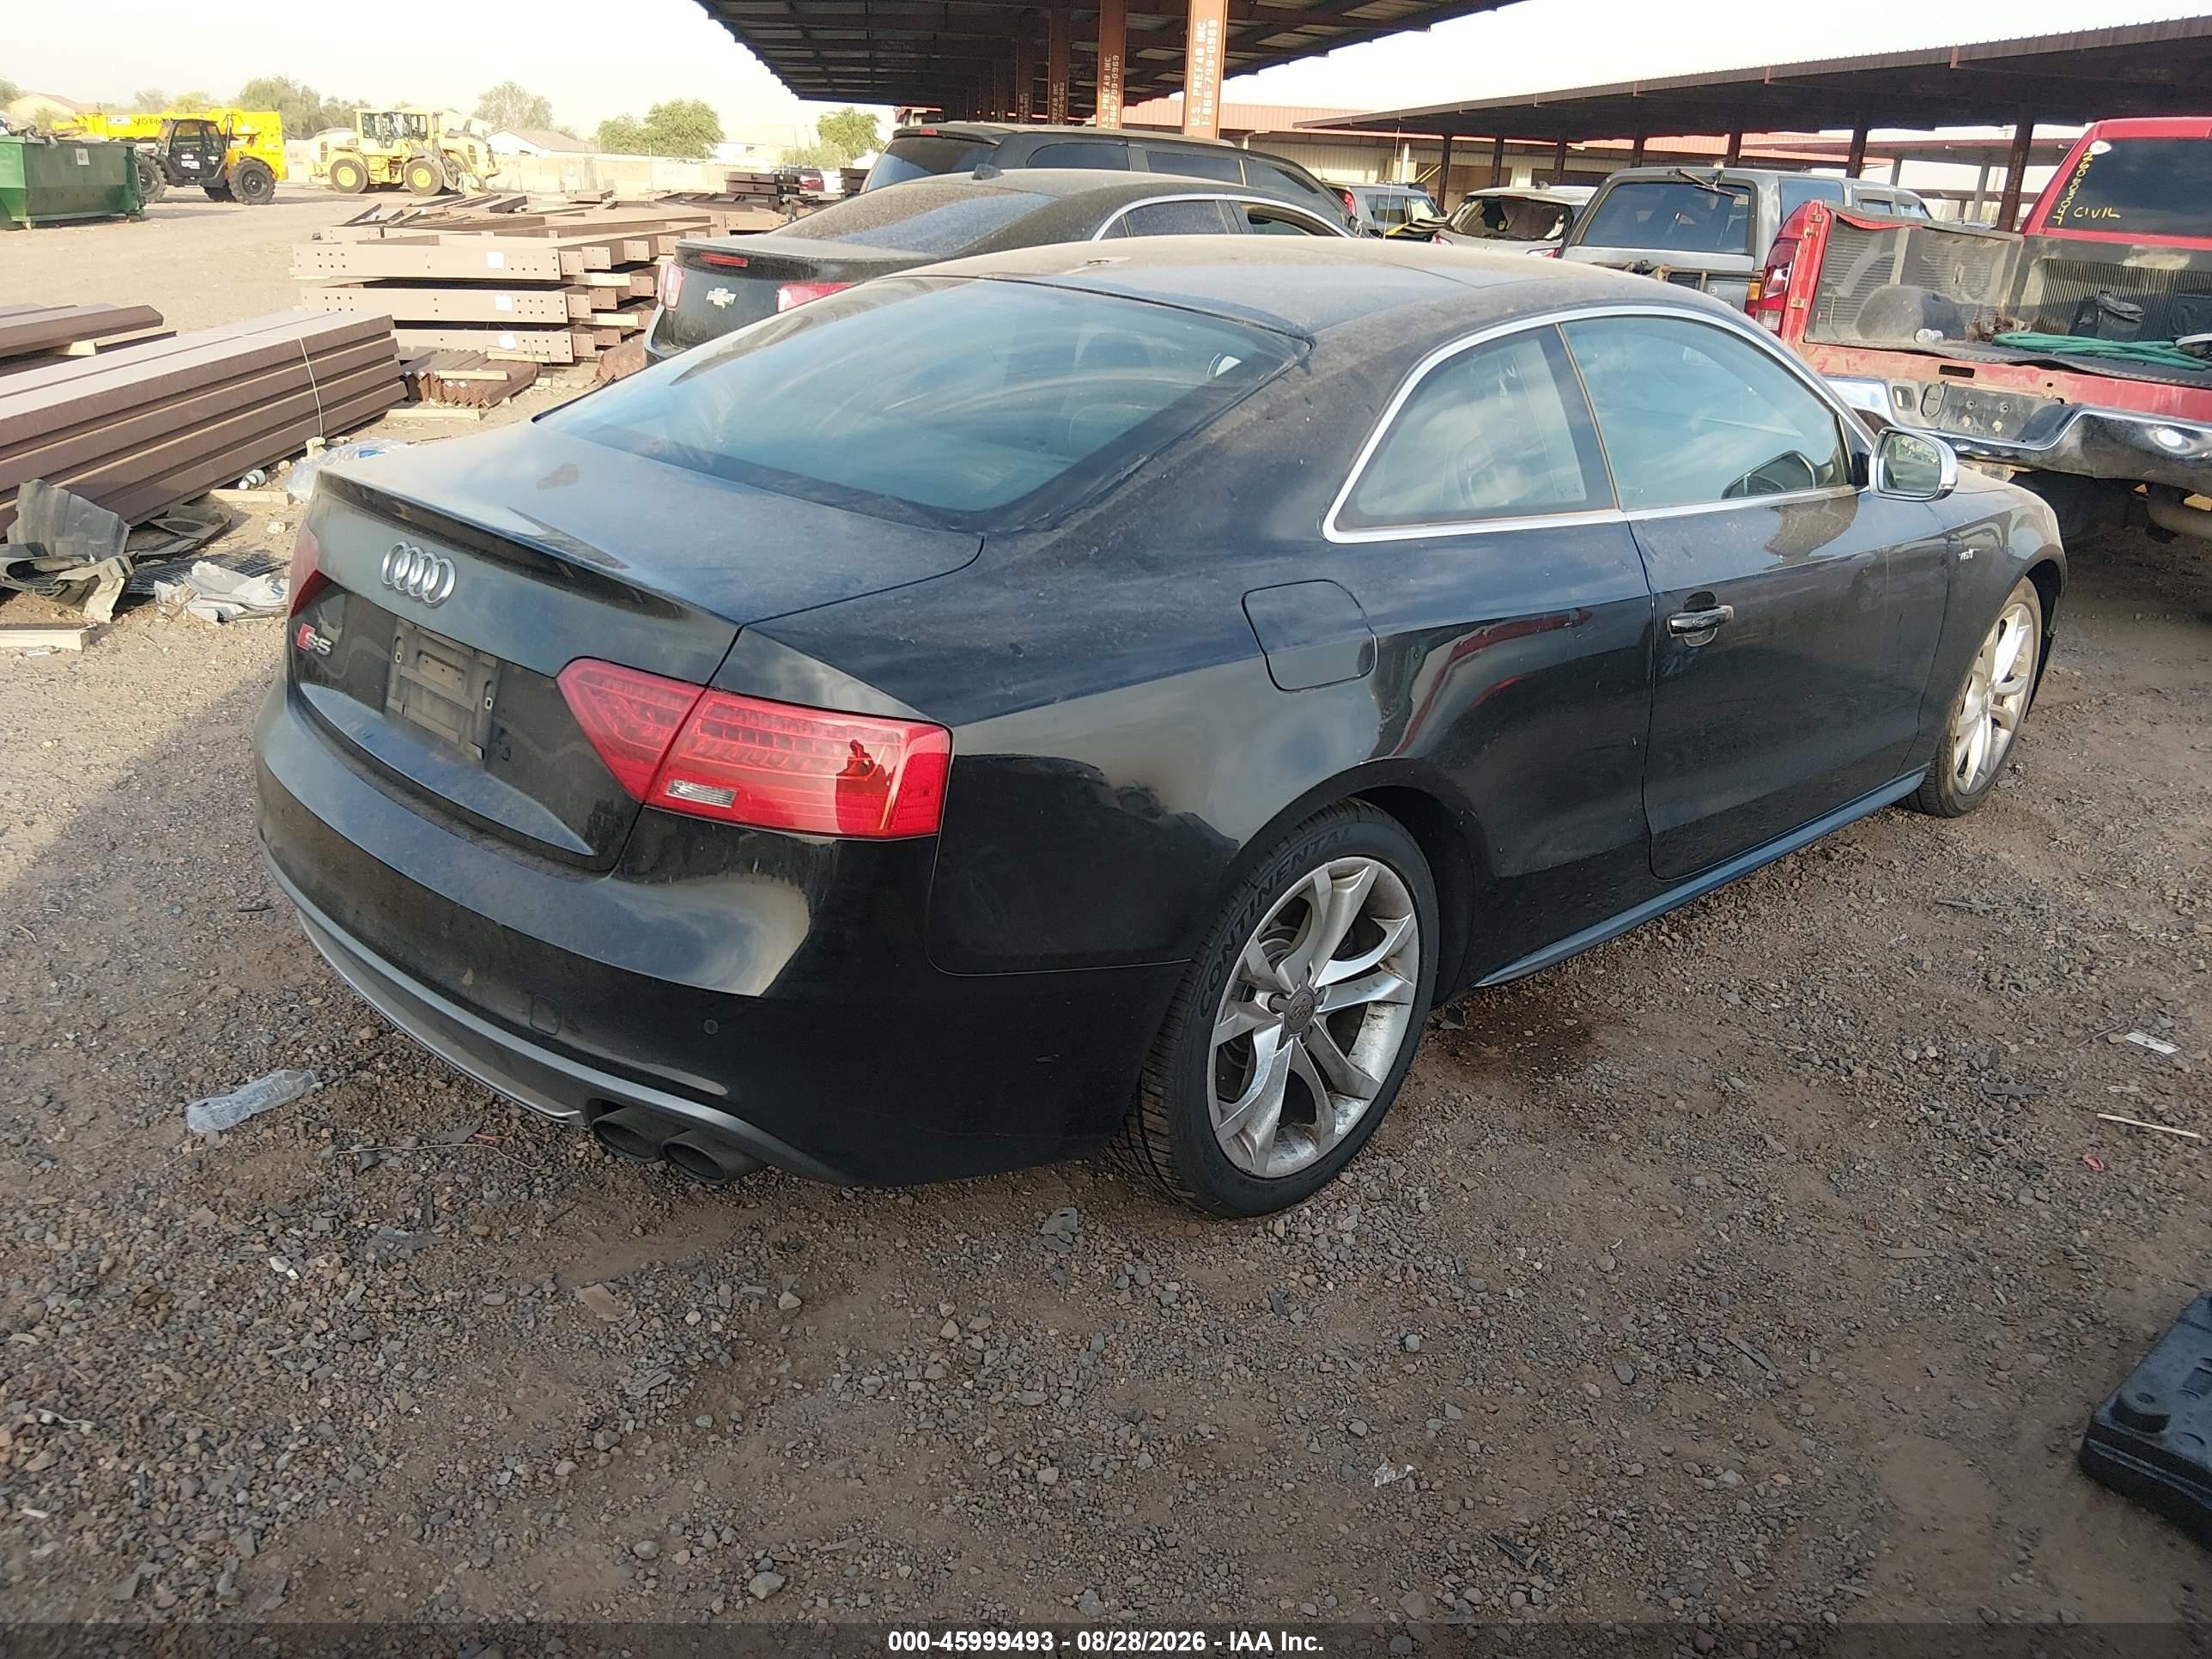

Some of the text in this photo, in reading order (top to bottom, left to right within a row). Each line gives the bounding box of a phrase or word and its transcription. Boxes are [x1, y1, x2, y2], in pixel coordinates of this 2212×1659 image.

[1102, 75, 1111, 110] PREFAB
[1193, 48, 1206, 97] PREFAB
[2074, 206, 2121, 219] CIVIL
[1200, 826, 1354, 1018] CONTINENTAL
